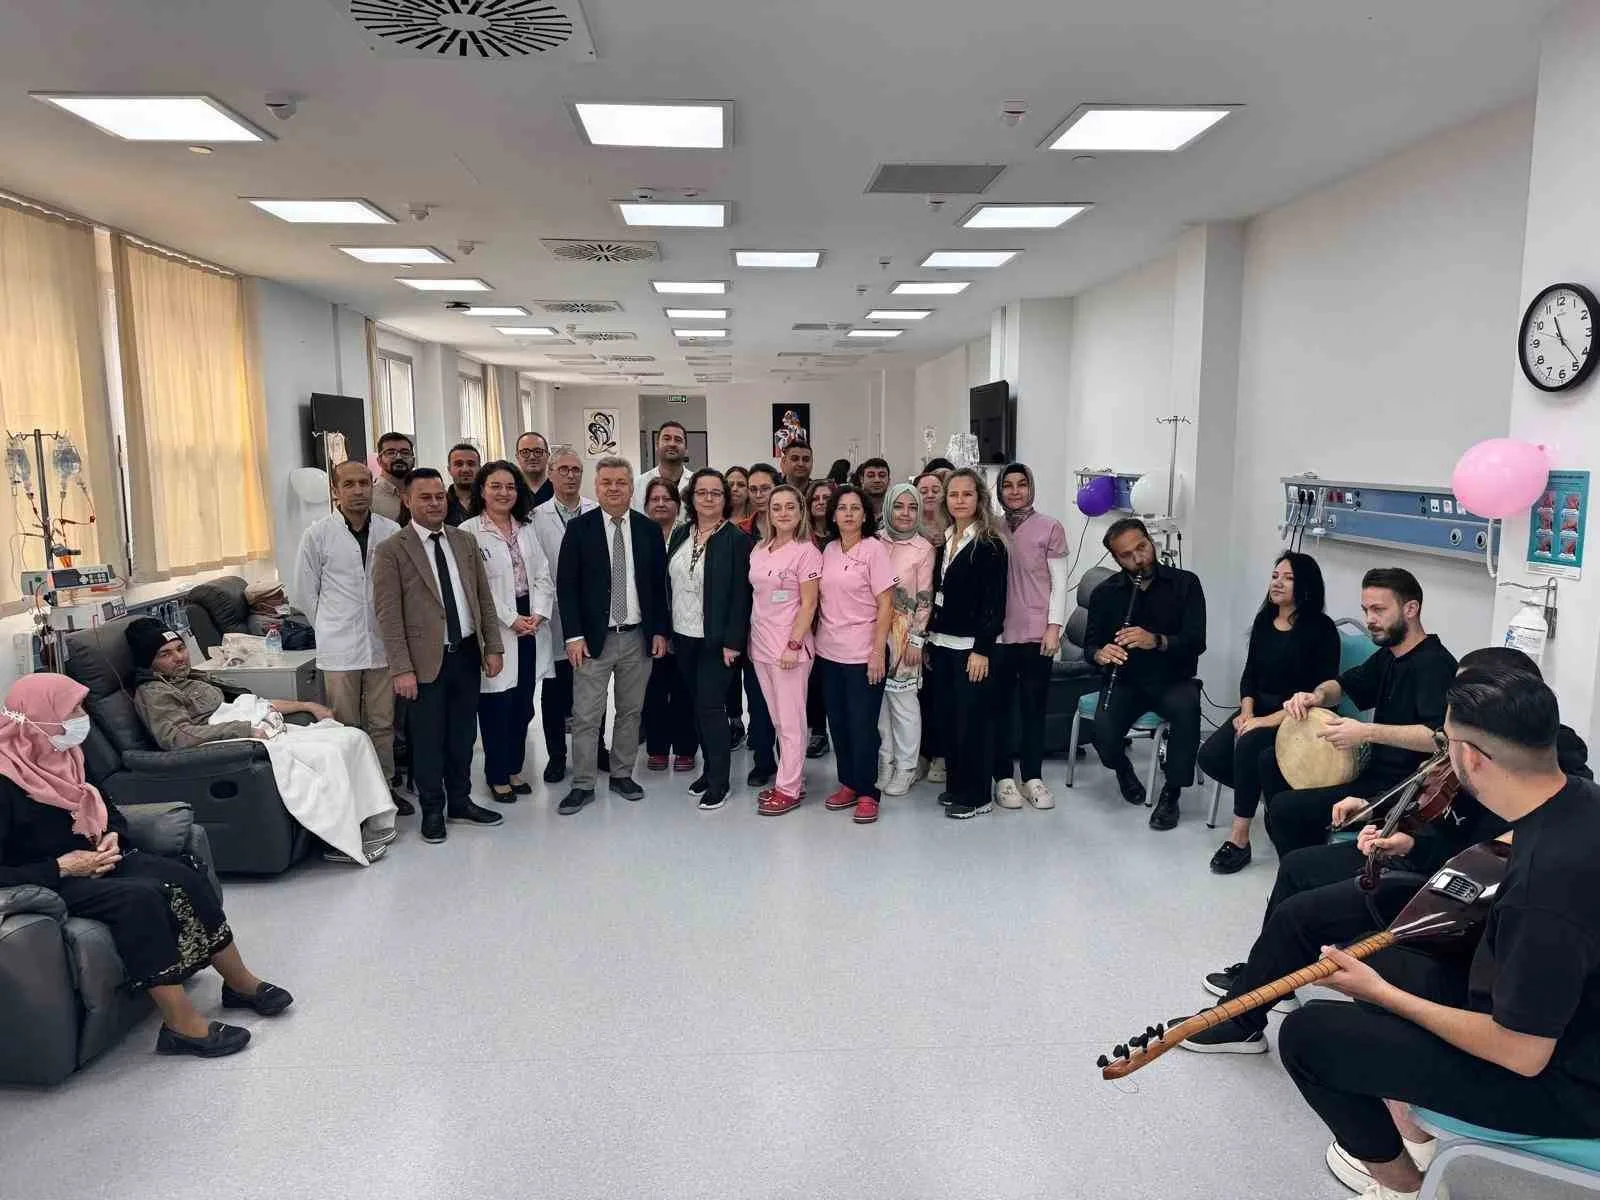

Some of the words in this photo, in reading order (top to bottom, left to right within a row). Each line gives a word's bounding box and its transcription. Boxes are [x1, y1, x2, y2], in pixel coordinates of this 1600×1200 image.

[1556, 296, 1566, 306] 12
[1546, 305, 1551, 314] 11
[1580, 310, 1588, 320] 2
[1537, 321, 1544, 330] 10
[1585, 327, 1592, 337] 3
[1533, 339, 1540, 348] 9
[1582, 346, 1589, 355] 4
[1537, 355, 1544, 365] 8
[1547, 366, 1552, 376] 7
[1572, 361, 1579, 371] 5
[1559, 370, 1566, 379] 6
